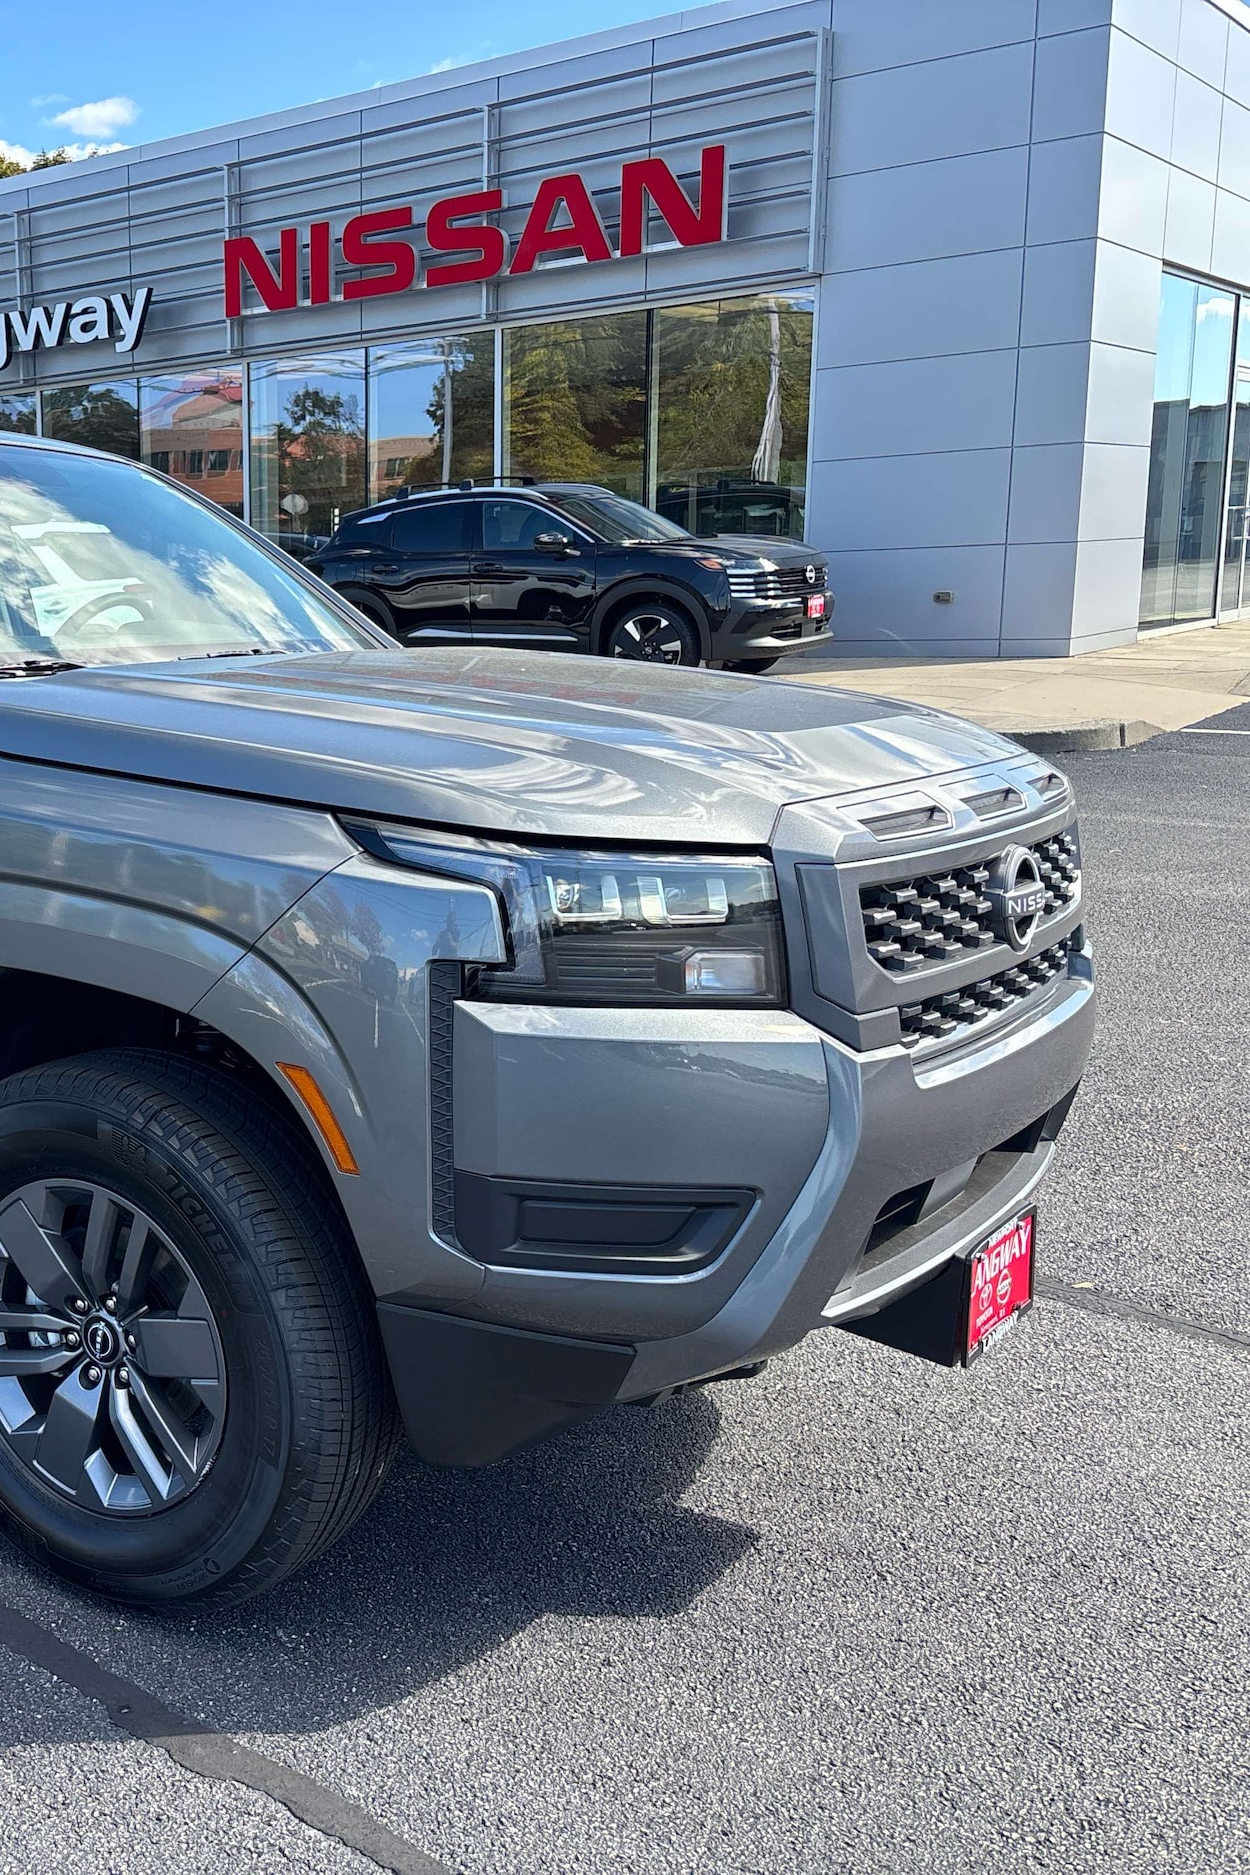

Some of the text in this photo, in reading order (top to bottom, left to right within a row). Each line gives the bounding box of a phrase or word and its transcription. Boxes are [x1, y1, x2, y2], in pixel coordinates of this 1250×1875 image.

[224, 145, 726, 318] NISSAN
[1008, 892, 1045, 914] NISS
[971, 1225, 1030, 1298] ANGWAY
